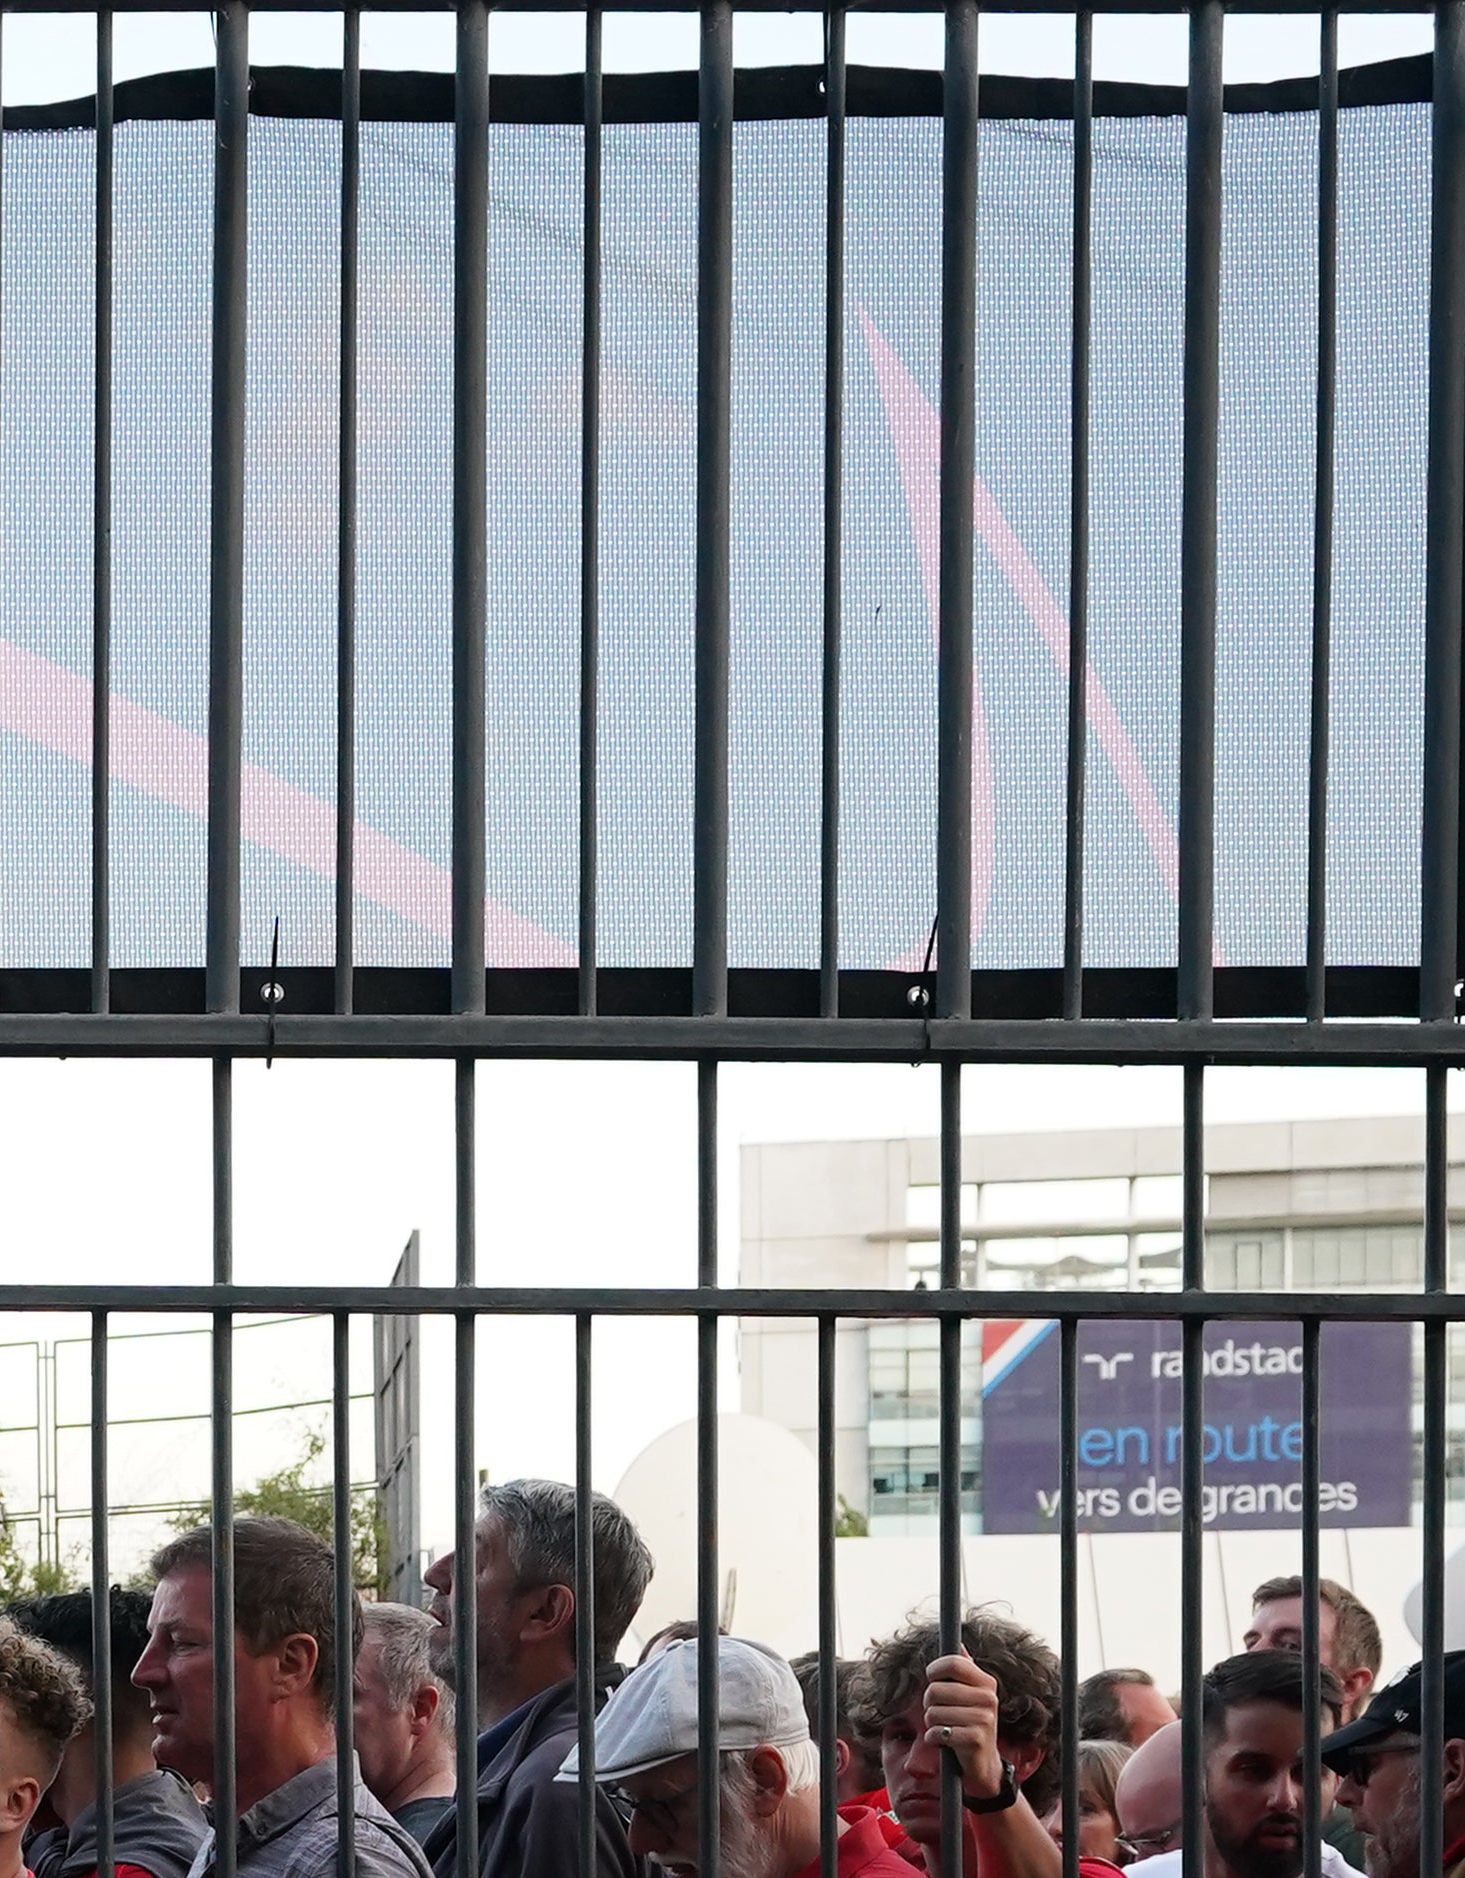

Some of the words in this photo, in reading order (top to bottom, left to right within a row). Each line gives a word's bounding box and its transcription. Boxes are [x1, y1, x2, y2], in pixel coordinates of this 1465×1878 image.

[1152, 1340, 1303, 1377] radsta
[1079, 1426, 1148, 1466] en
[1129, 1477, 1183, 1517] de
